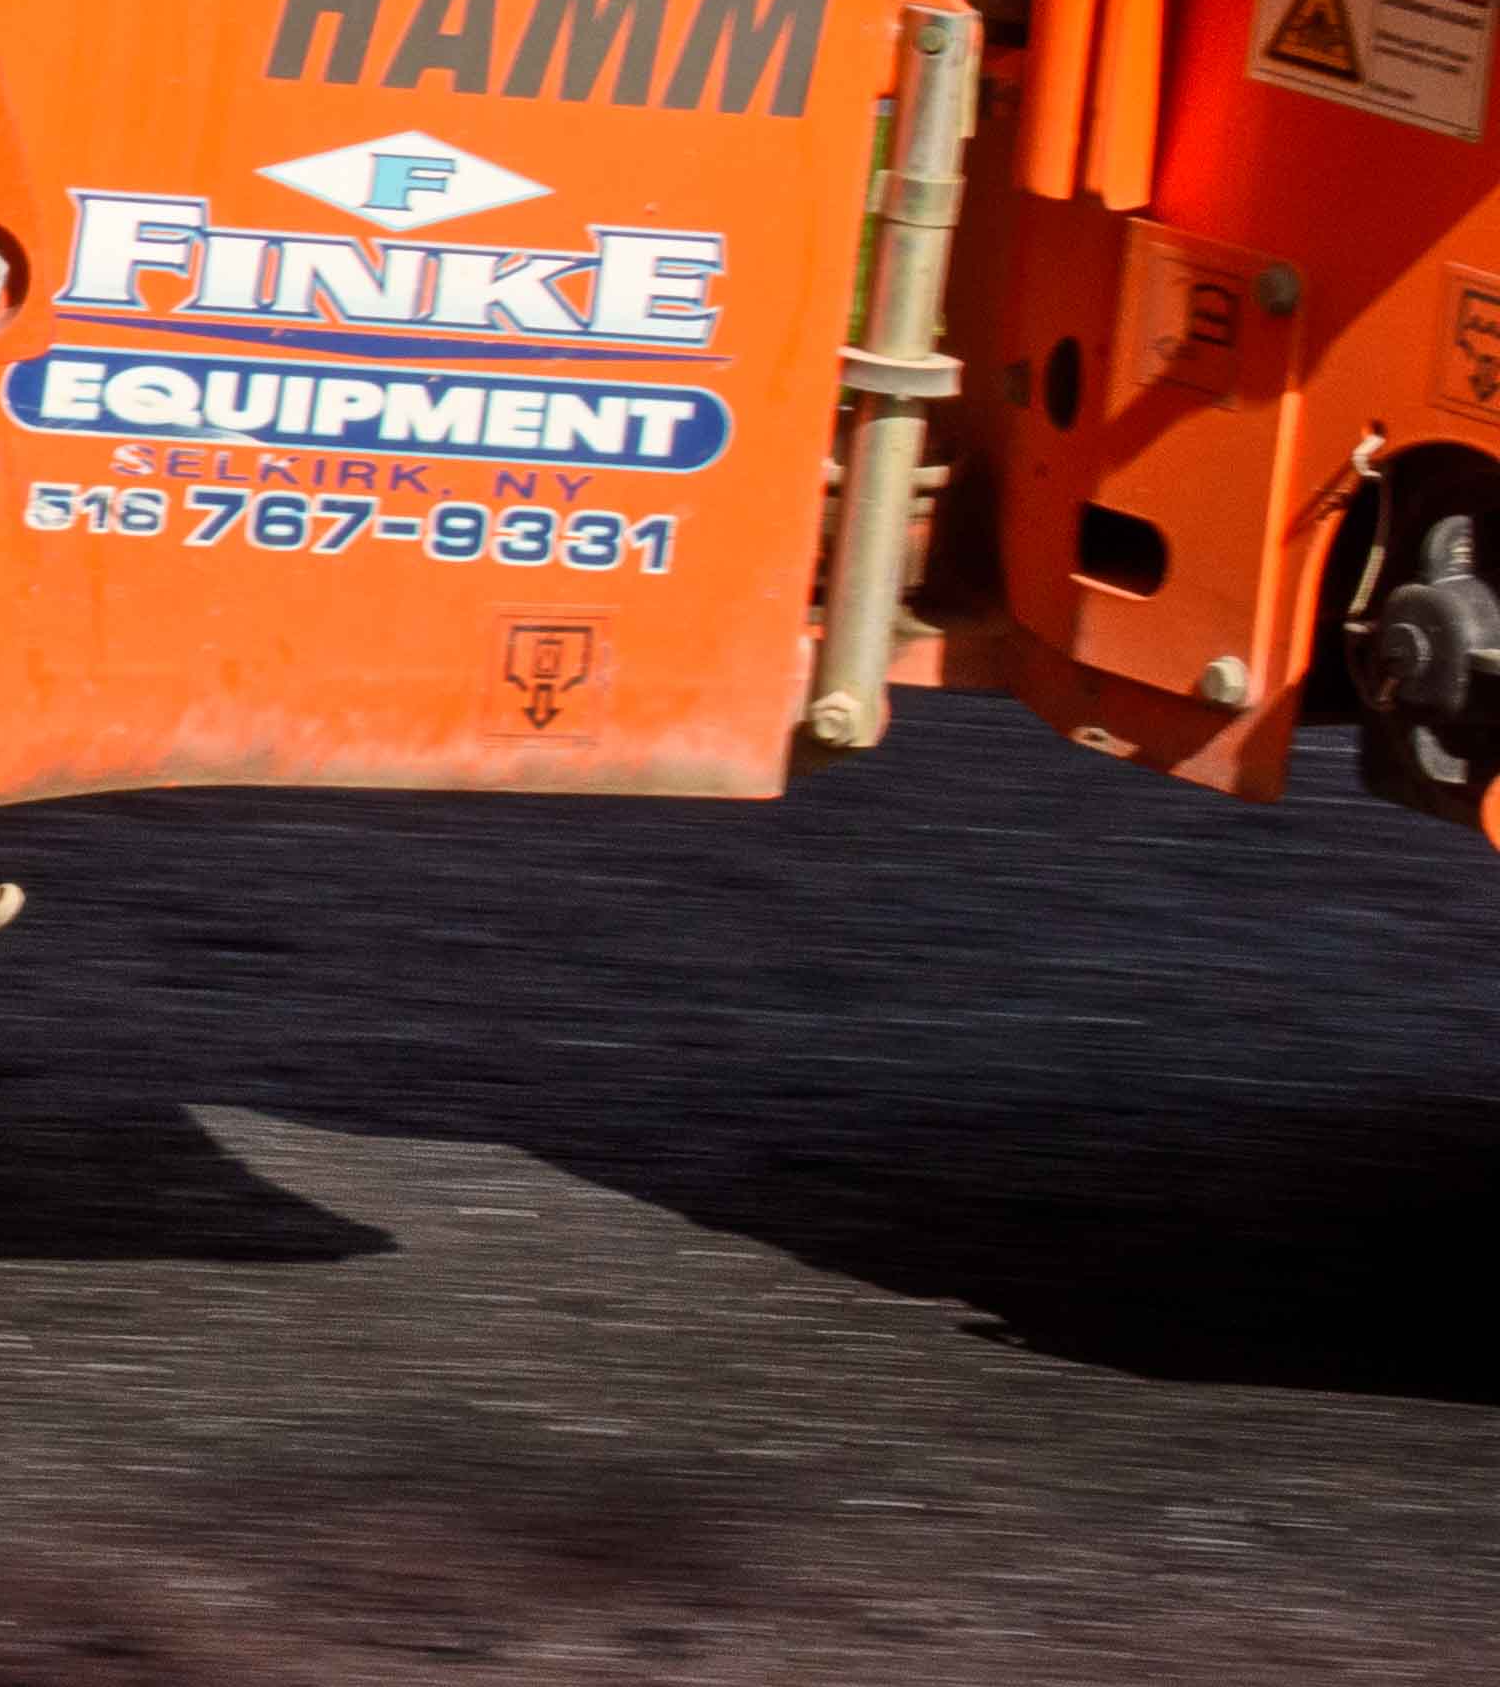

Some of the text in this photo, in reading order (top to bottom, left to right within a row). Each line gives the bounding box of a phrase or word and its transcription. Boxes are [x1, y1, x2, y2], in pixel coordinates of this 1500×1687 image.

[369, 153, 457, 212] F
[54, 189, 725, 345] FINKE
[41, 361, 695, 457] EQUIPMENT
[183, 484, 677, 575] 767-9331
[494, 470, 597, 502] NY
